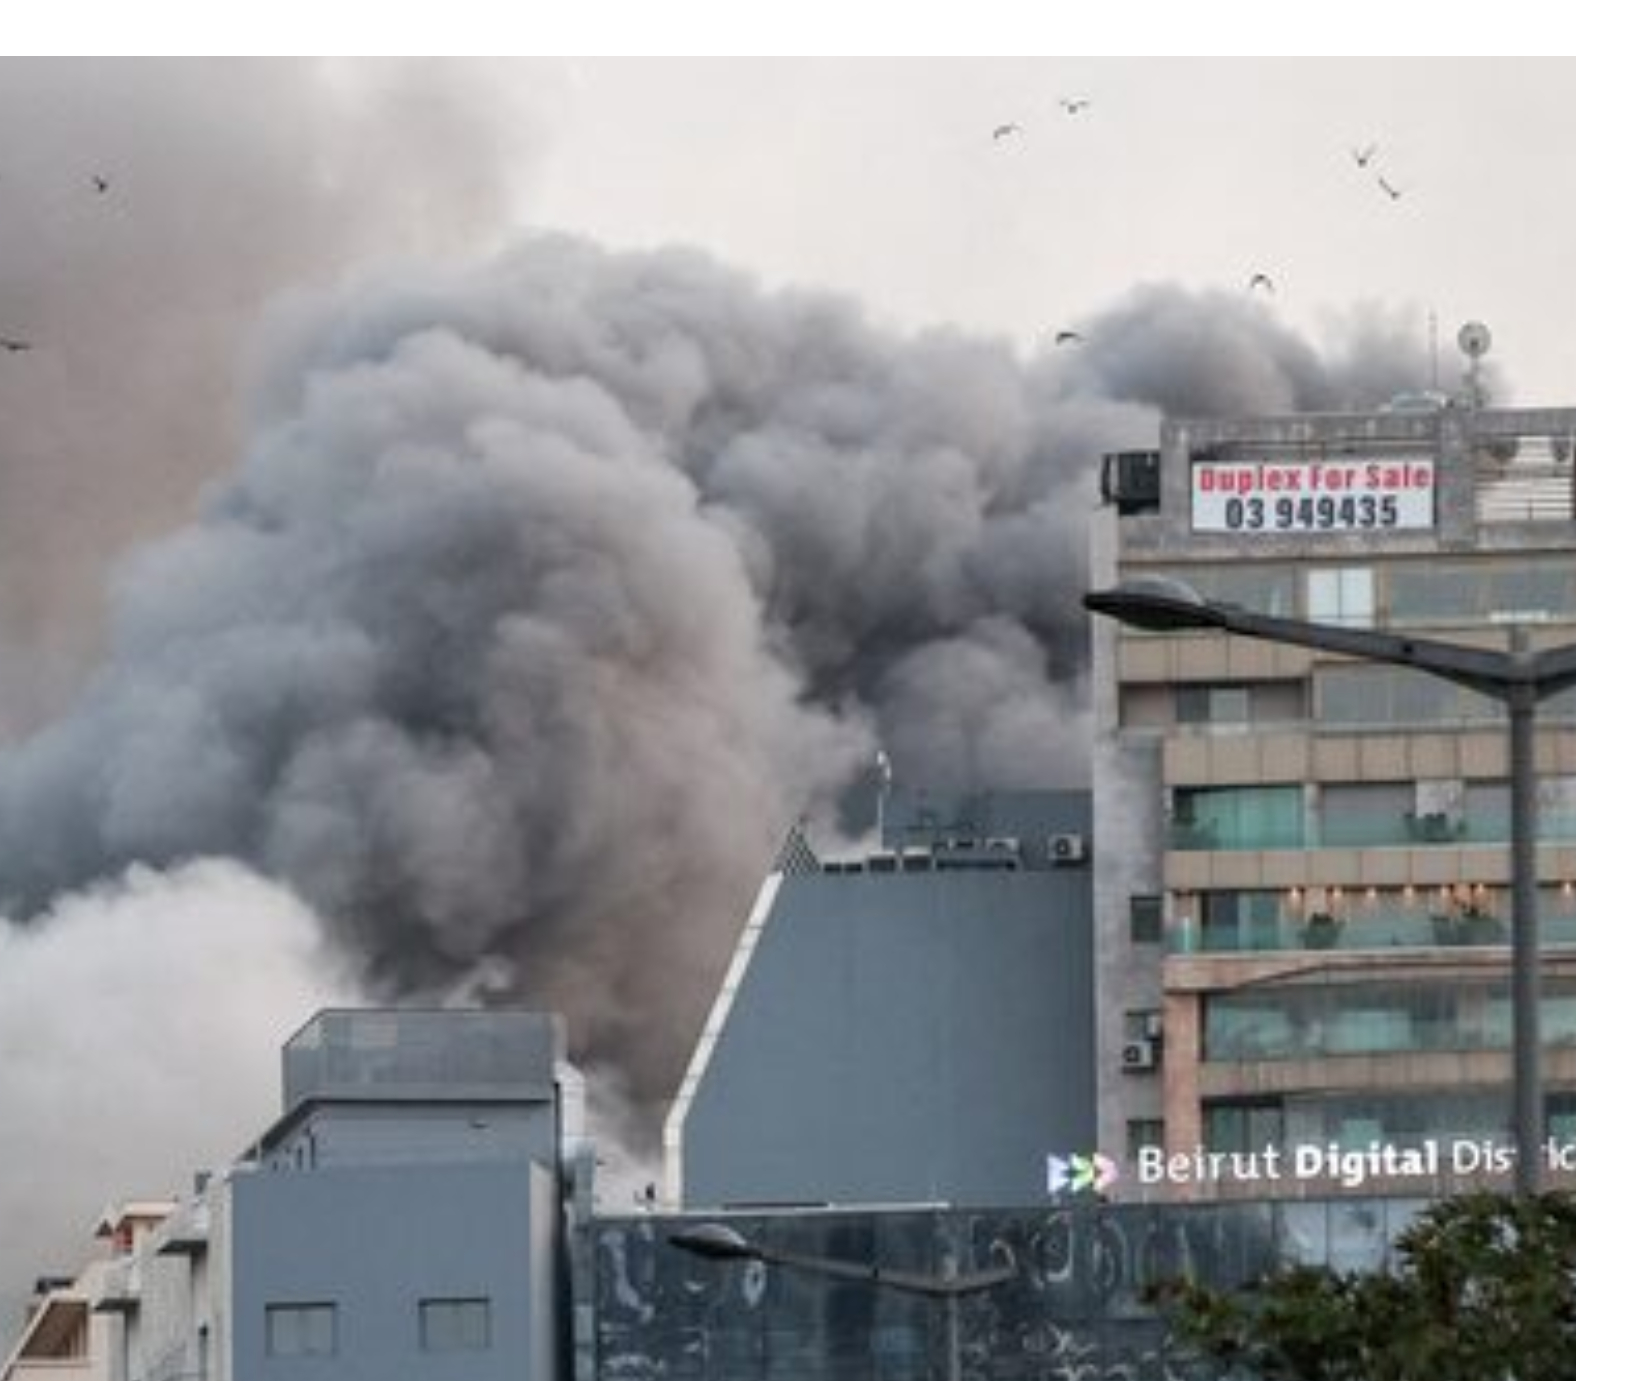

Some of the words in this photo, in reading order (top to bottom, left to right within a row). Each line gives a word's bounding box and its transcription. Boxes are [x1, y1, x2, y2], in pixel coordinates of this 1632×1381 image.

[1200, 465, 1301, 495] Duplex
[1309, 466, 1355, 491] For
[1365, 463, 1430, 490] Sale
[1225, 496, 1264, 529] 03
[1275, 494, 1398, 529] 949435
[1137, 1144, 1281, 1183] Beirut
[1294, 1139, 1439, 1187] Digital
